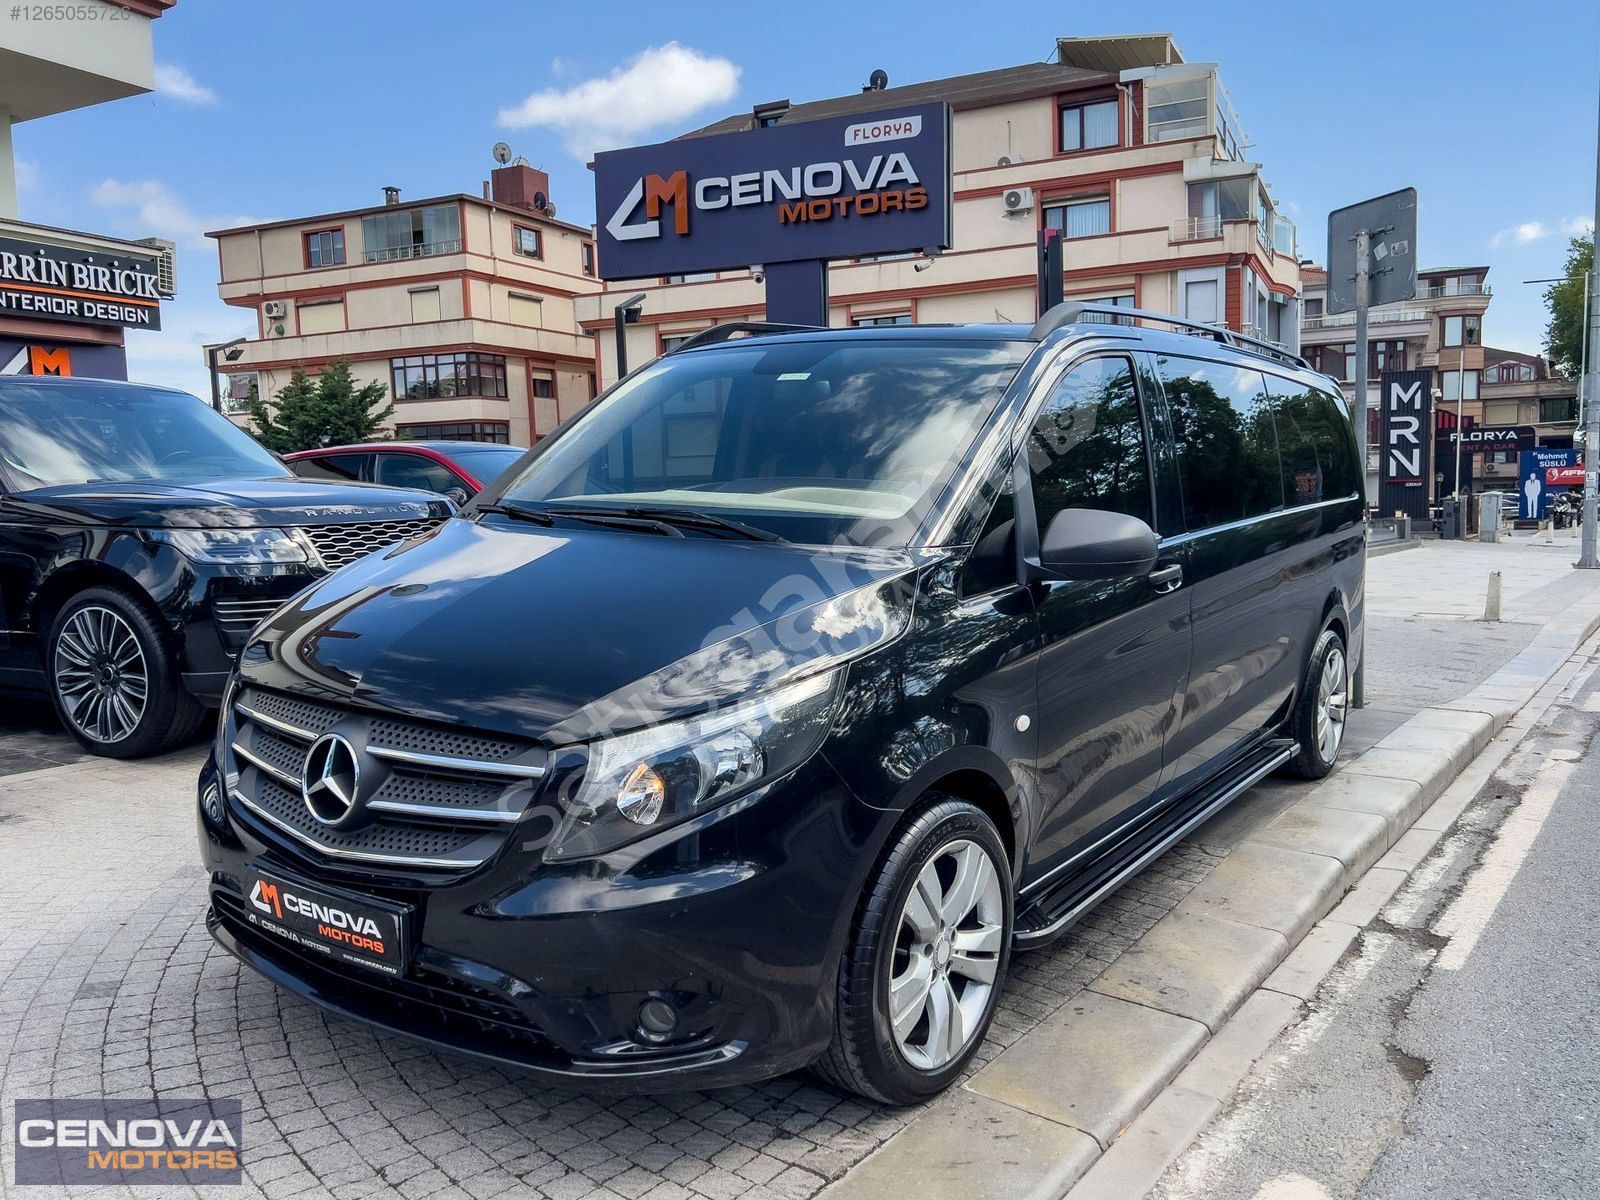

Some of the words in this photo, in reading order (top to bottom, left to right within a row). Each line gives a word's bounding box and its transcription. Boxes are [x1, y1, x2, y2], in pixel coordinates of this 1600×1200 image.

[853, 122, 913, 142] FLORYA
[695, 152, 920, 210] CENOVA
[779, 187, 928, 225] MOTORS
[84, 302, 149, 324] DESIGN
[1389, 381, 1421, 477] MRN
[282, 892, 383, 939] CENOVA
[318, 924, 385, 954] MOTORS
